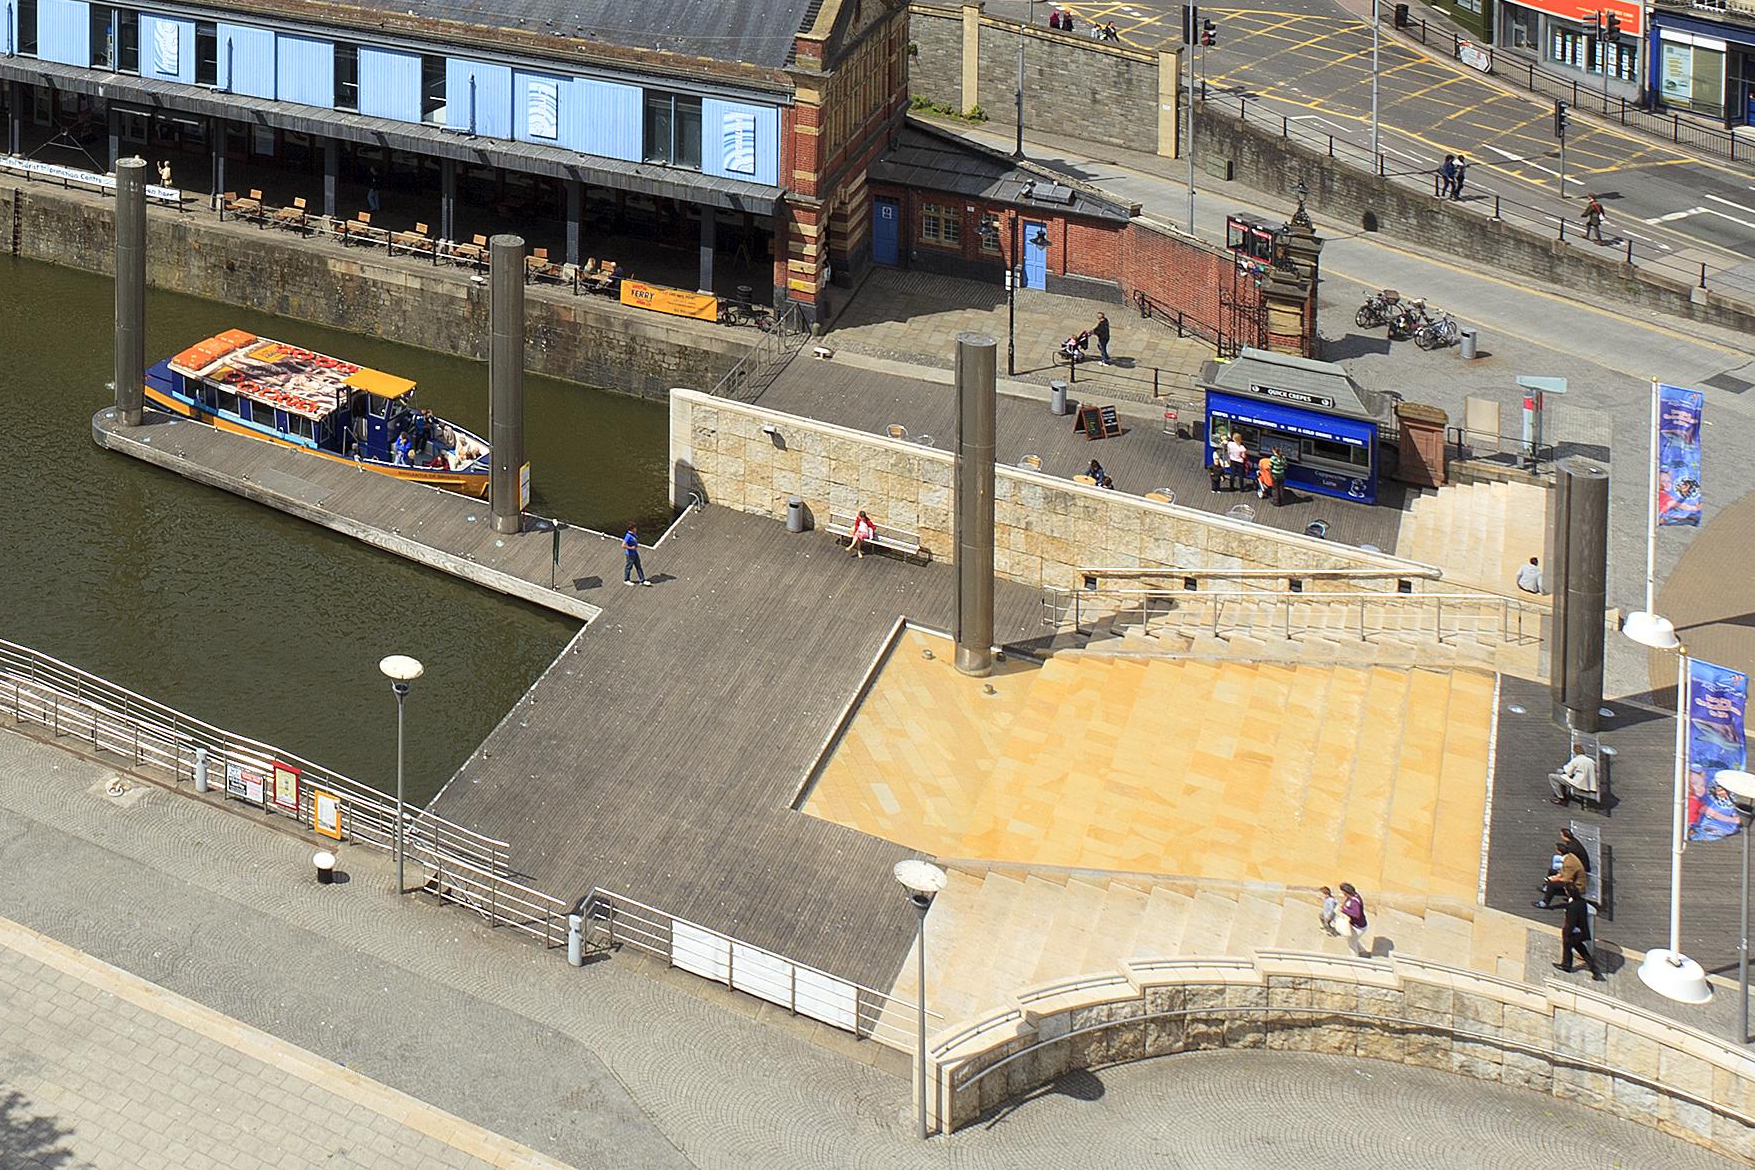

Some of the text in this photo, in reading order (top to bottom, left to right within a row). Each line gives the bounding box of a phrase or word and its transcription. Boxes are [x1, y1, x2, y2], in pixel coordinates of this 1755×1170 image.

[80, 173, 103, 184] Centre
[631, 289, 654, 300] FERRY
[1267, 388, 1311, 403] QUICK CREPES
